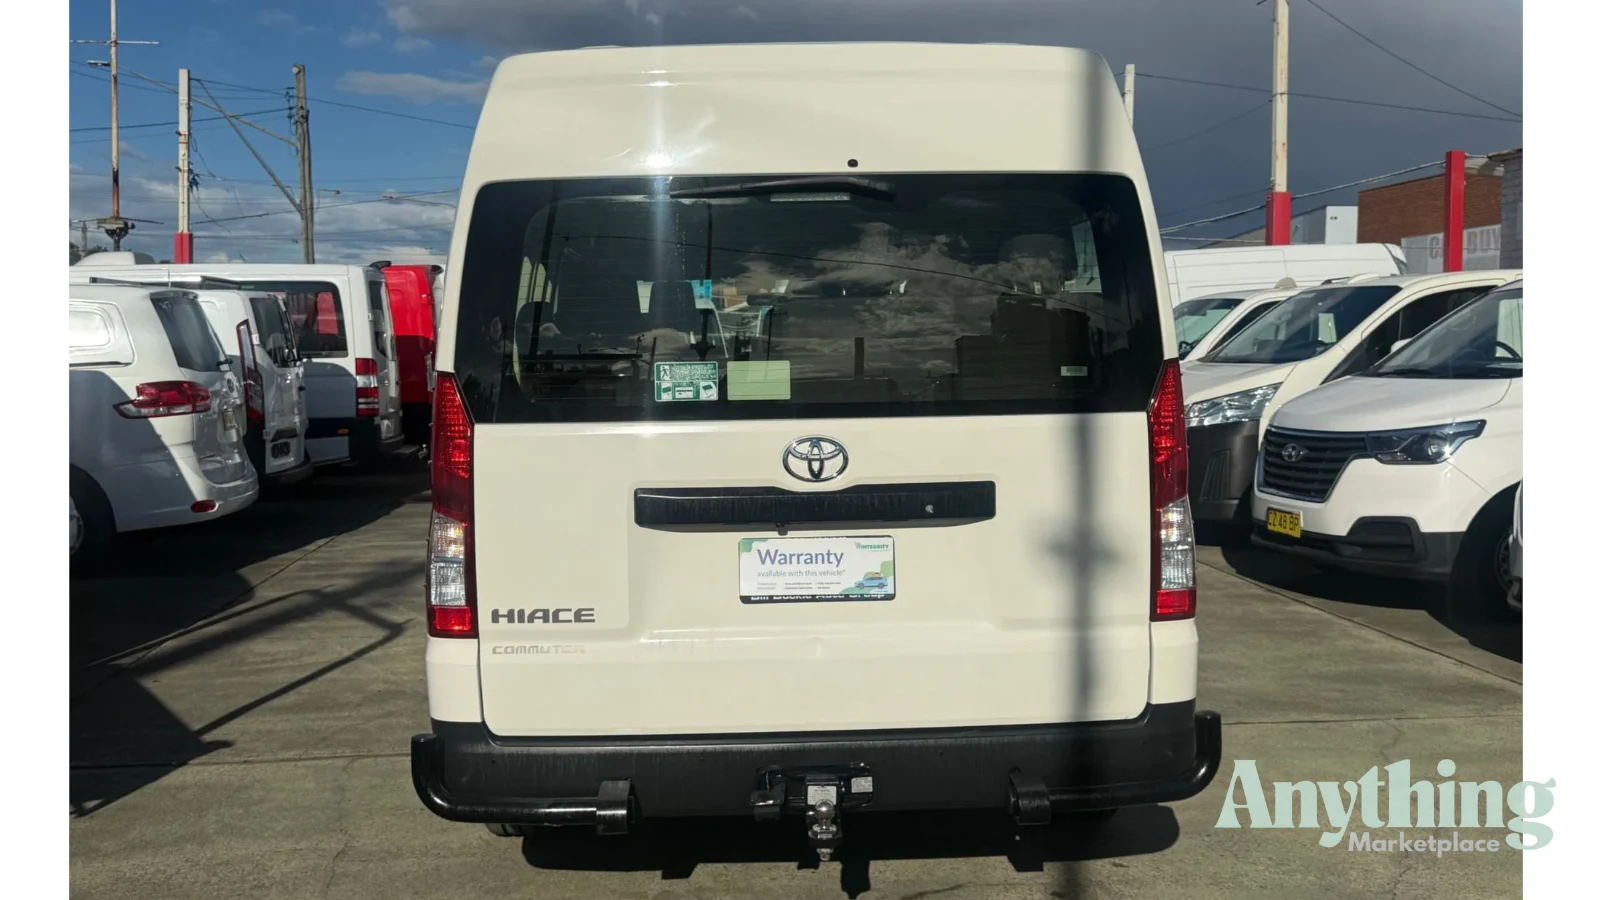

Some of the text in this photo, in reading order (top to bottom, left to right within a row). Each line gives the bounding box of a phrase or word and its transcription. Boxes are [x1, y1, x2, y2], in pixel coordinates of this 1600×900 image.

[757, 548, 844, 568] Warranty
[757, 569, 787, 577] available
[788, 569, 804, 577] with
[805, 569, 818, 577] this
[491, 607, 596, 624] HIACE
[492, 645, 586, 655] COMMUTER
